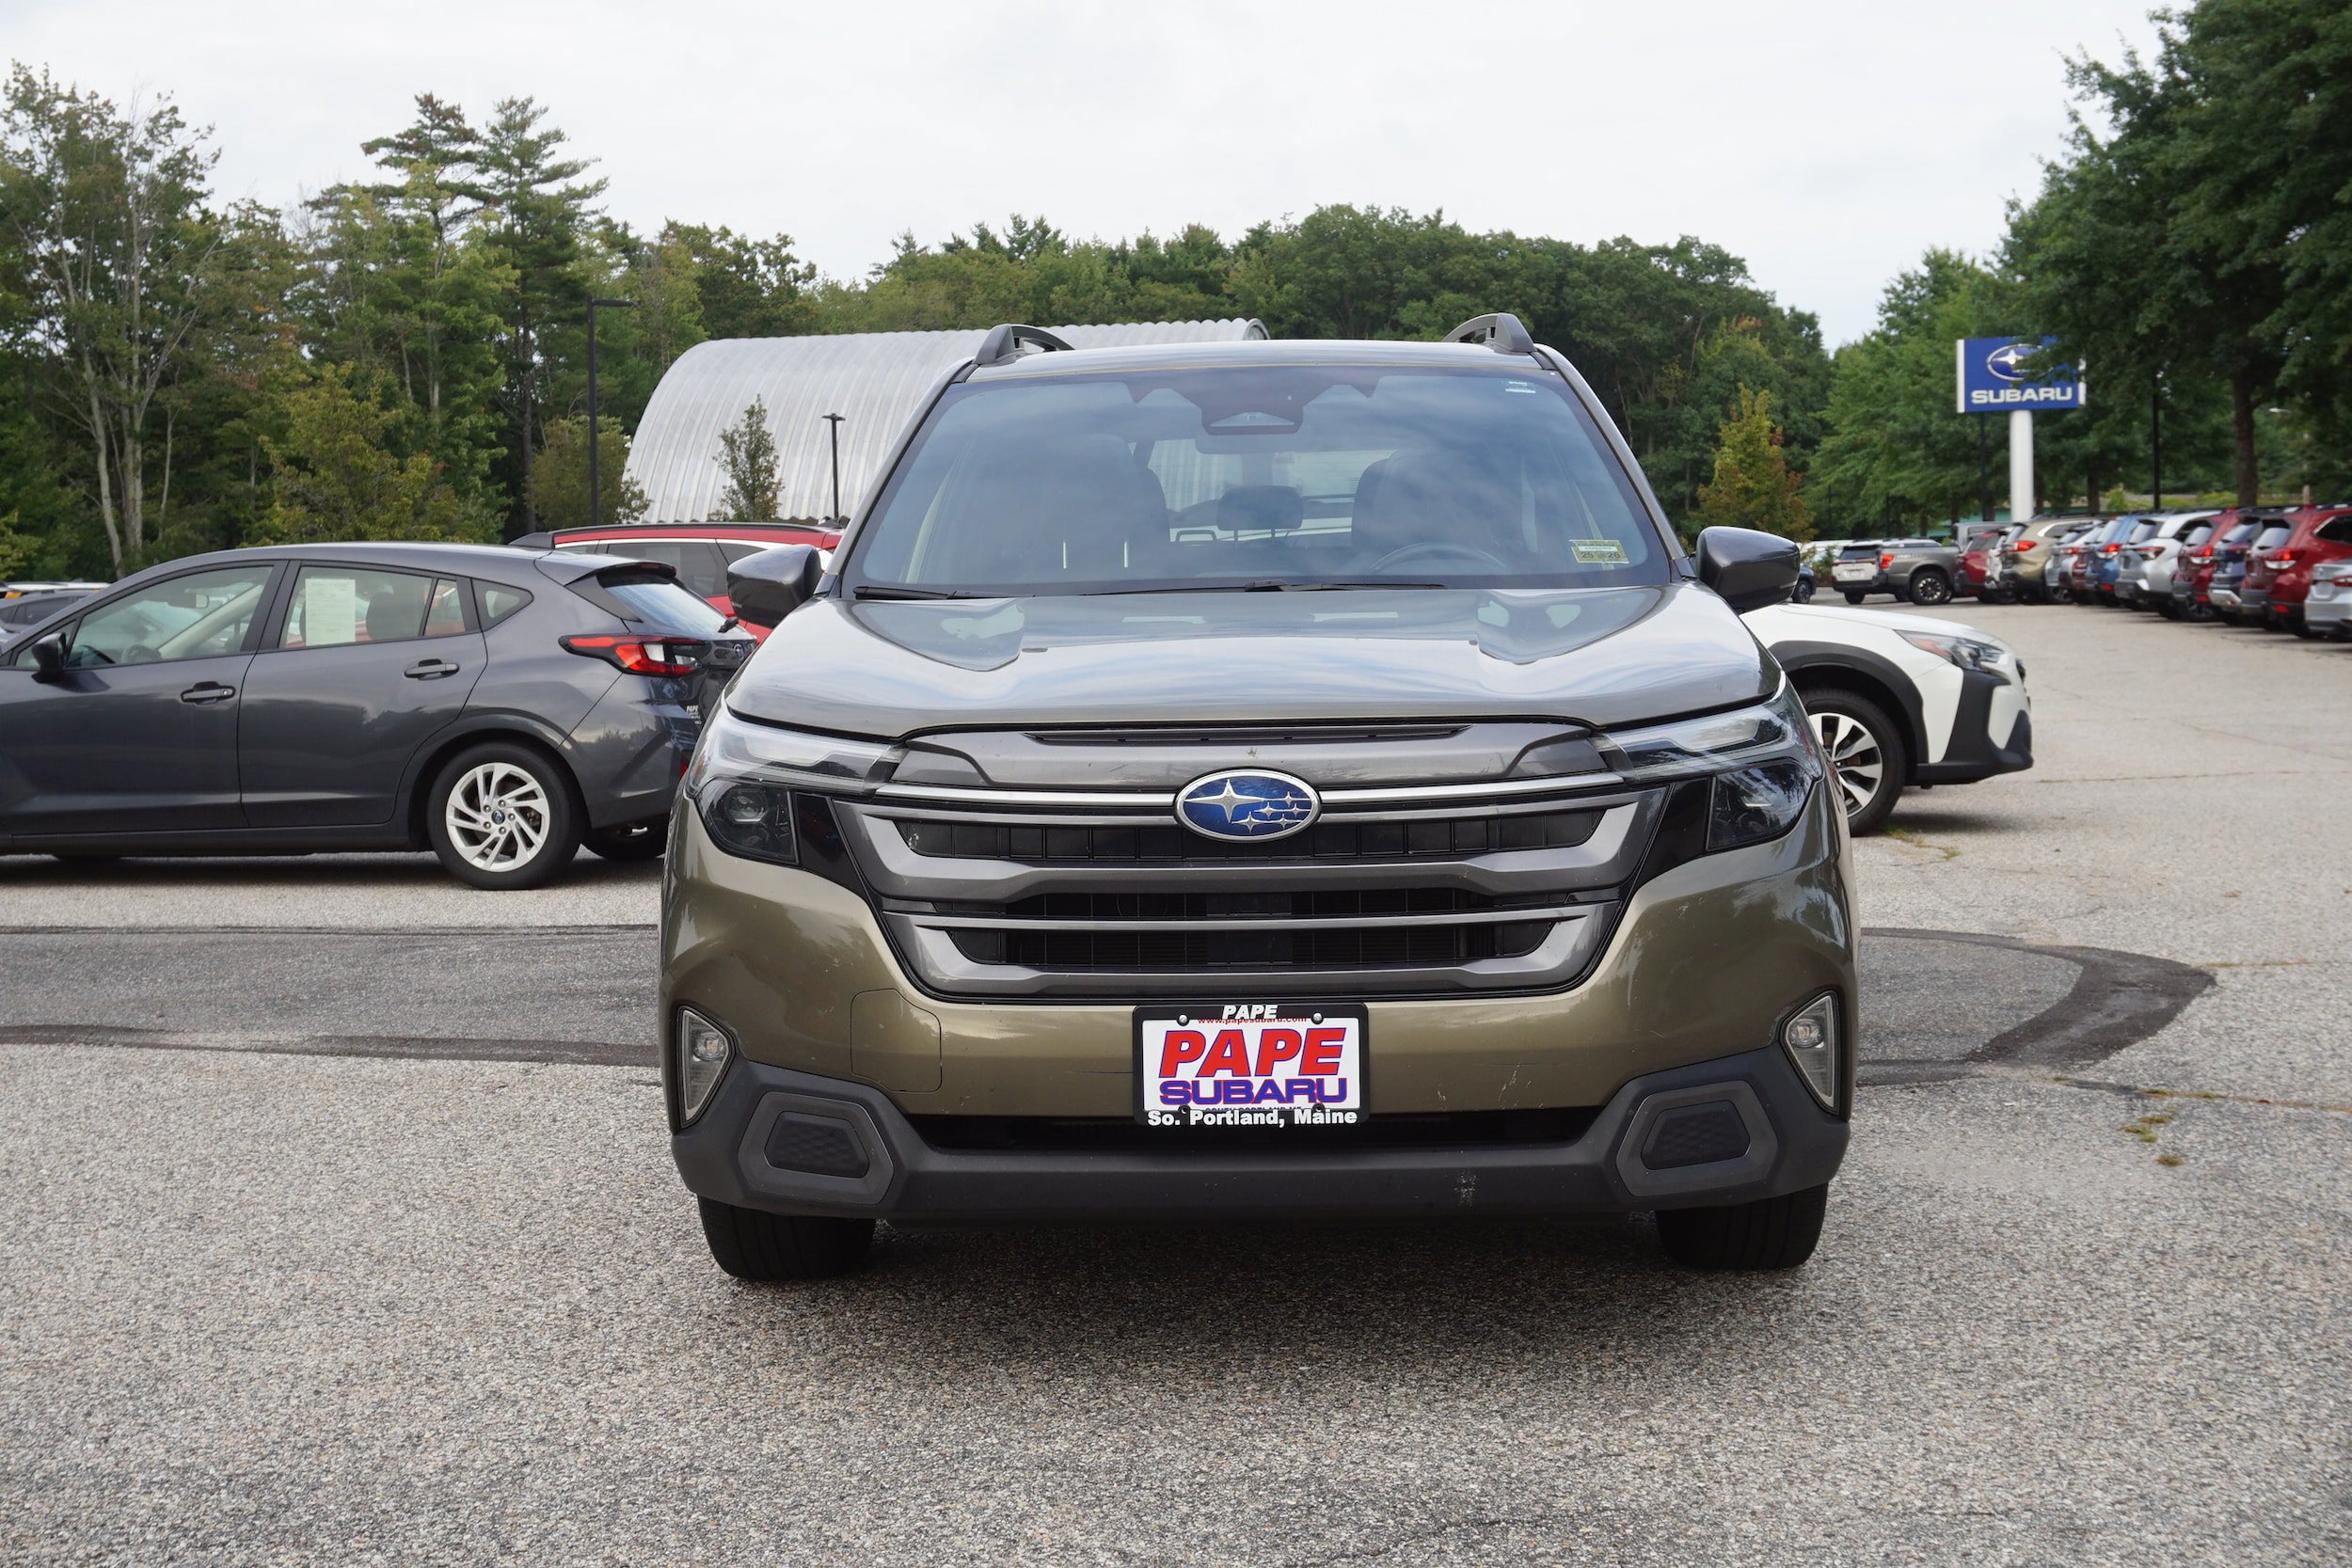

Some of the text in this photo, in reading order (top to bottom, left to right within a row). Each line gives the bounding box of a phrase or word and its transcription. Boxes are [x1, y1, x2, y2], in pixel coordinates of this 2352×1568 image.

[1971, 387, 2073, 404] SUBARU
[1222, 1004, 1279, 1020] PAPE
[1158, 1027, 1346, 1078] PAPE
[1159, 1078, 1347, 1105] SUBARU
[1147, 1109, 1358, 1128] So. Portland, Maine
